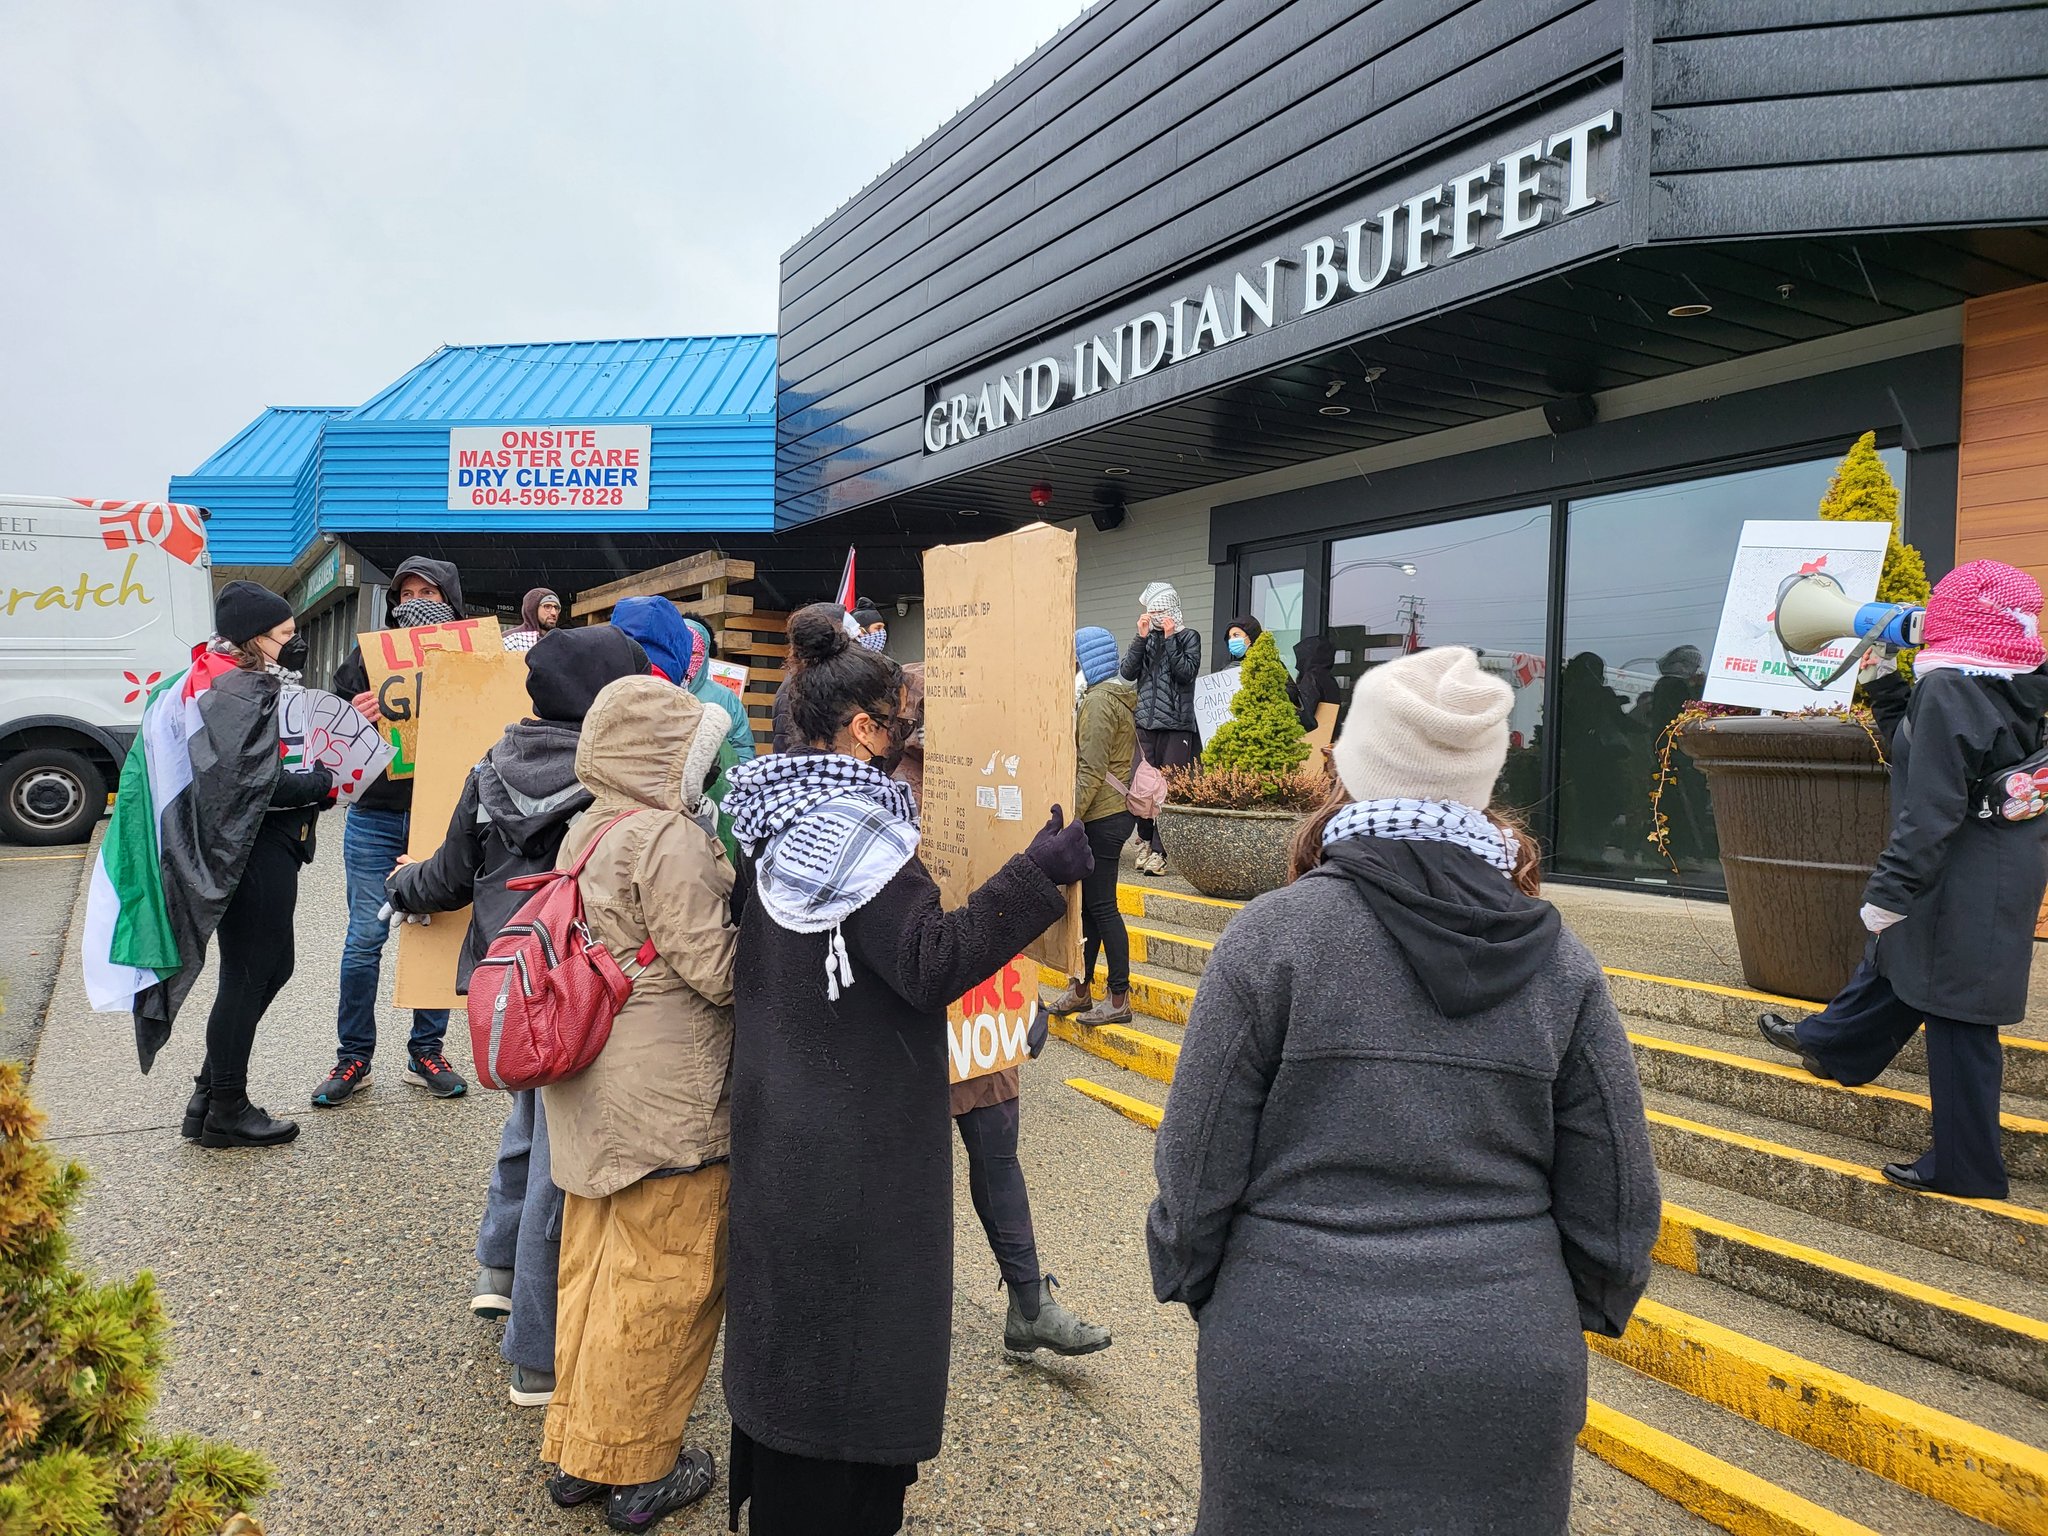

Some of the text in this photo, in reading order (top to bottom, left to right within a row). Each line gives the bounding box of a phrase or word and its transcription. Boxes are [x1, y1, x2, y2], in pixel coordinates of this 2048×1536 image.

[924, 108, 1617, 453] GRAND INDIAN BUFFET
[502, 430, 595, 449] ONSITE
[459, 449, 639, 467] MASTER CARE
[458, 468, 638, 487] DRY CLEANER
[472, 488, 623, 506] 604-596-7828
[0, 553, 155, 616] ratch
[926, 606, 951, 620] GARDENS
[951, 604, 967, 618] ALIVE
[1725, 656, 1758, 672] FREE
[1203, 672, 1232, 690] END
[926, 685, 967, 698] MADE IN CHINA
[1206, 707, 1233, 724] SUPP
[947, 1001, 1036, 1079] NOW
